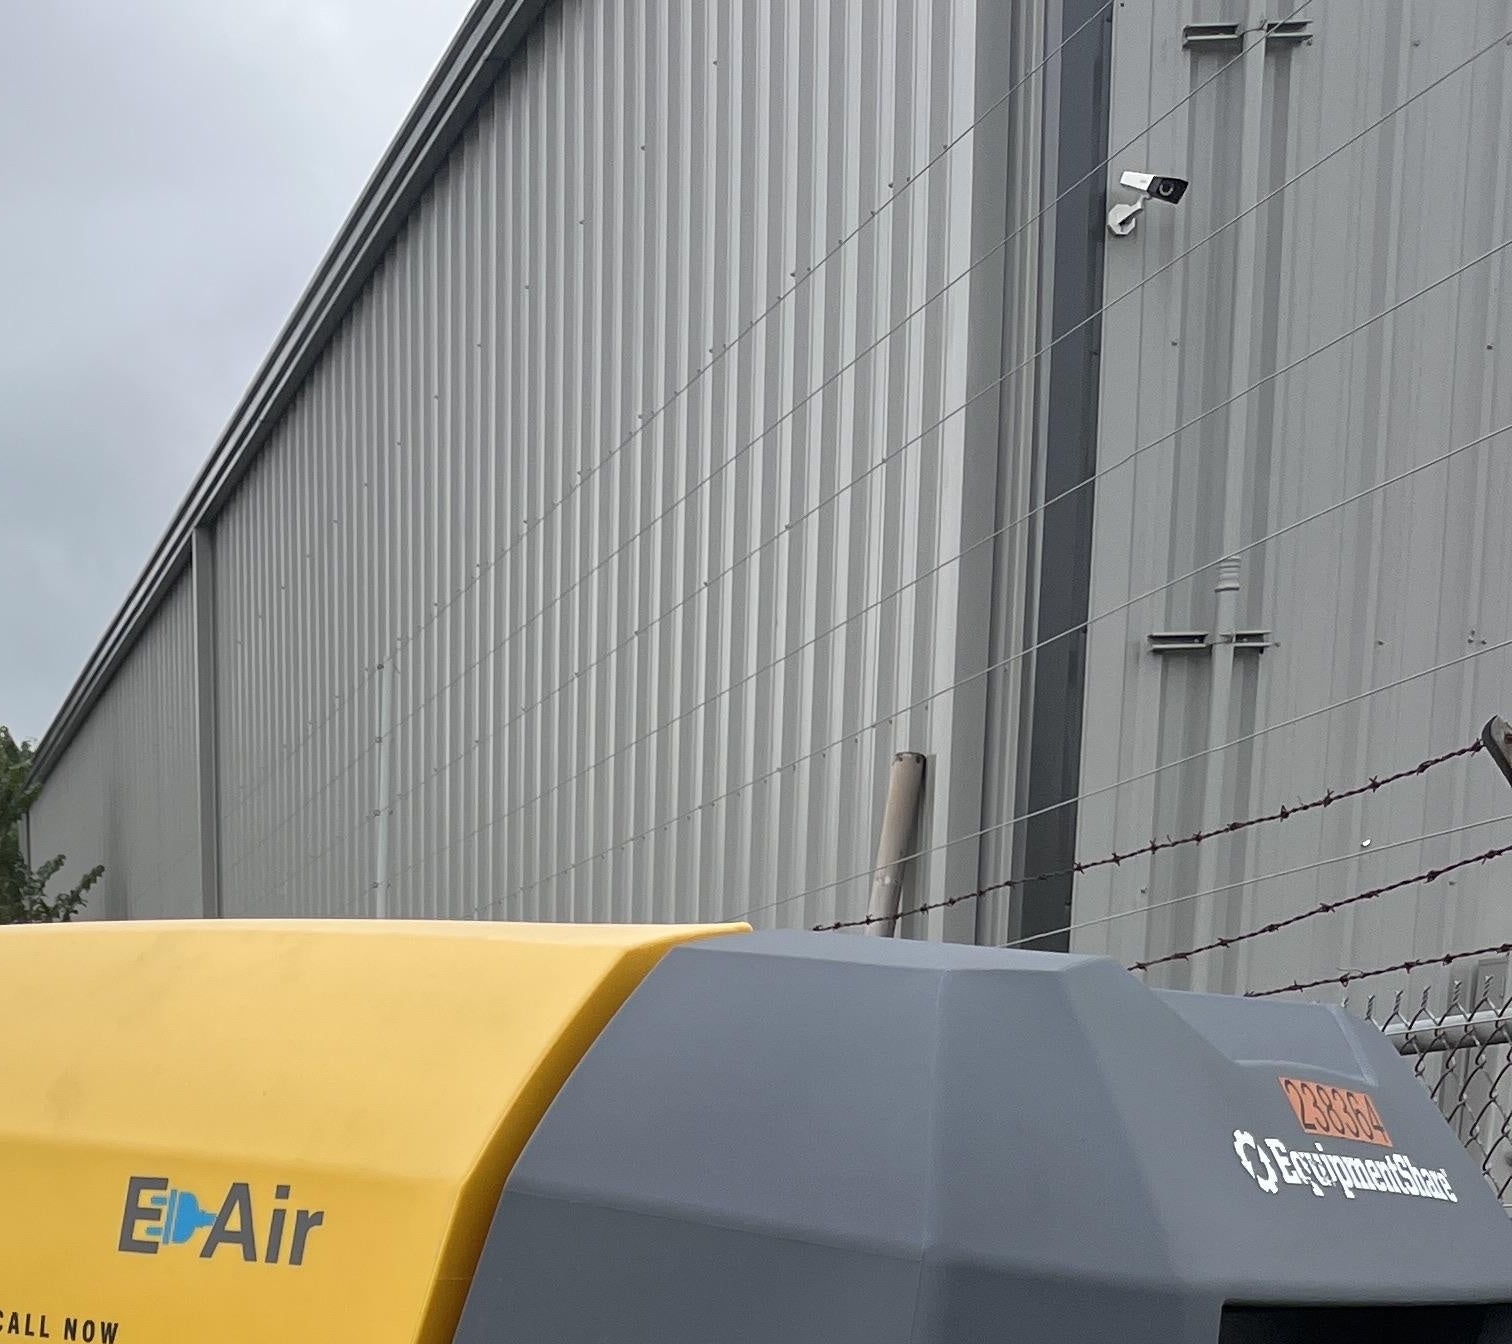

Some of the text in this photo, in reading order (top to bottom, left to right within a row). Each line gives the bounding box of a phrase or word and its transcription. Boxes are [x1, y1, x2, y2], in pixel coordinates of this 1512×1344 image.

[1284, 1079, 1387, 1145] 238364
[1265, 1138, 1459, 1203] EquipmentShare
[199, 1182, 324, 1266] Air
